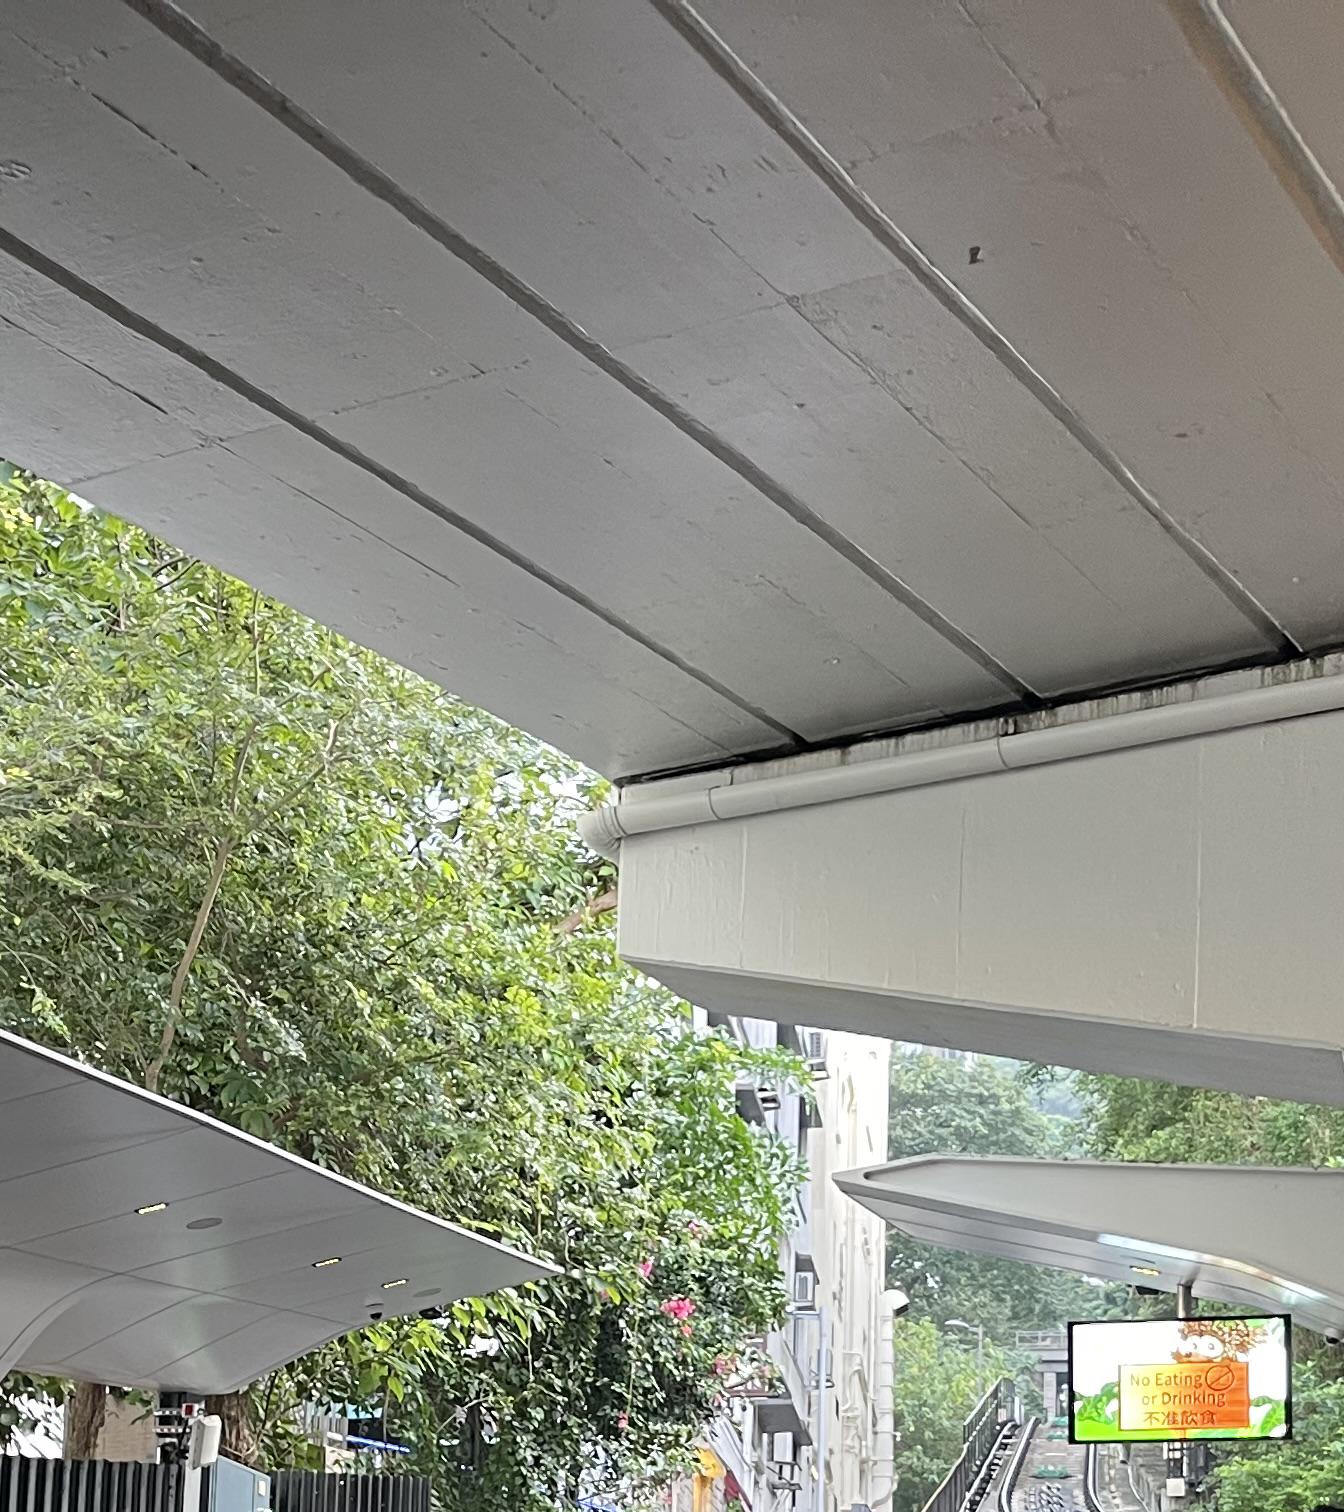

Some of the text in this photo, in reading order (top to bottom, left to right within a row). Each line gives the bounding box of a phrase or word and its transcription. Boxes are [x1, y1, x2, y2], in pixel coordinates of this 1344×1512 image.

[1130, 1371, 1203, 1389] No Eating
[1142, 1389, 1226, 1408] or Drinking
